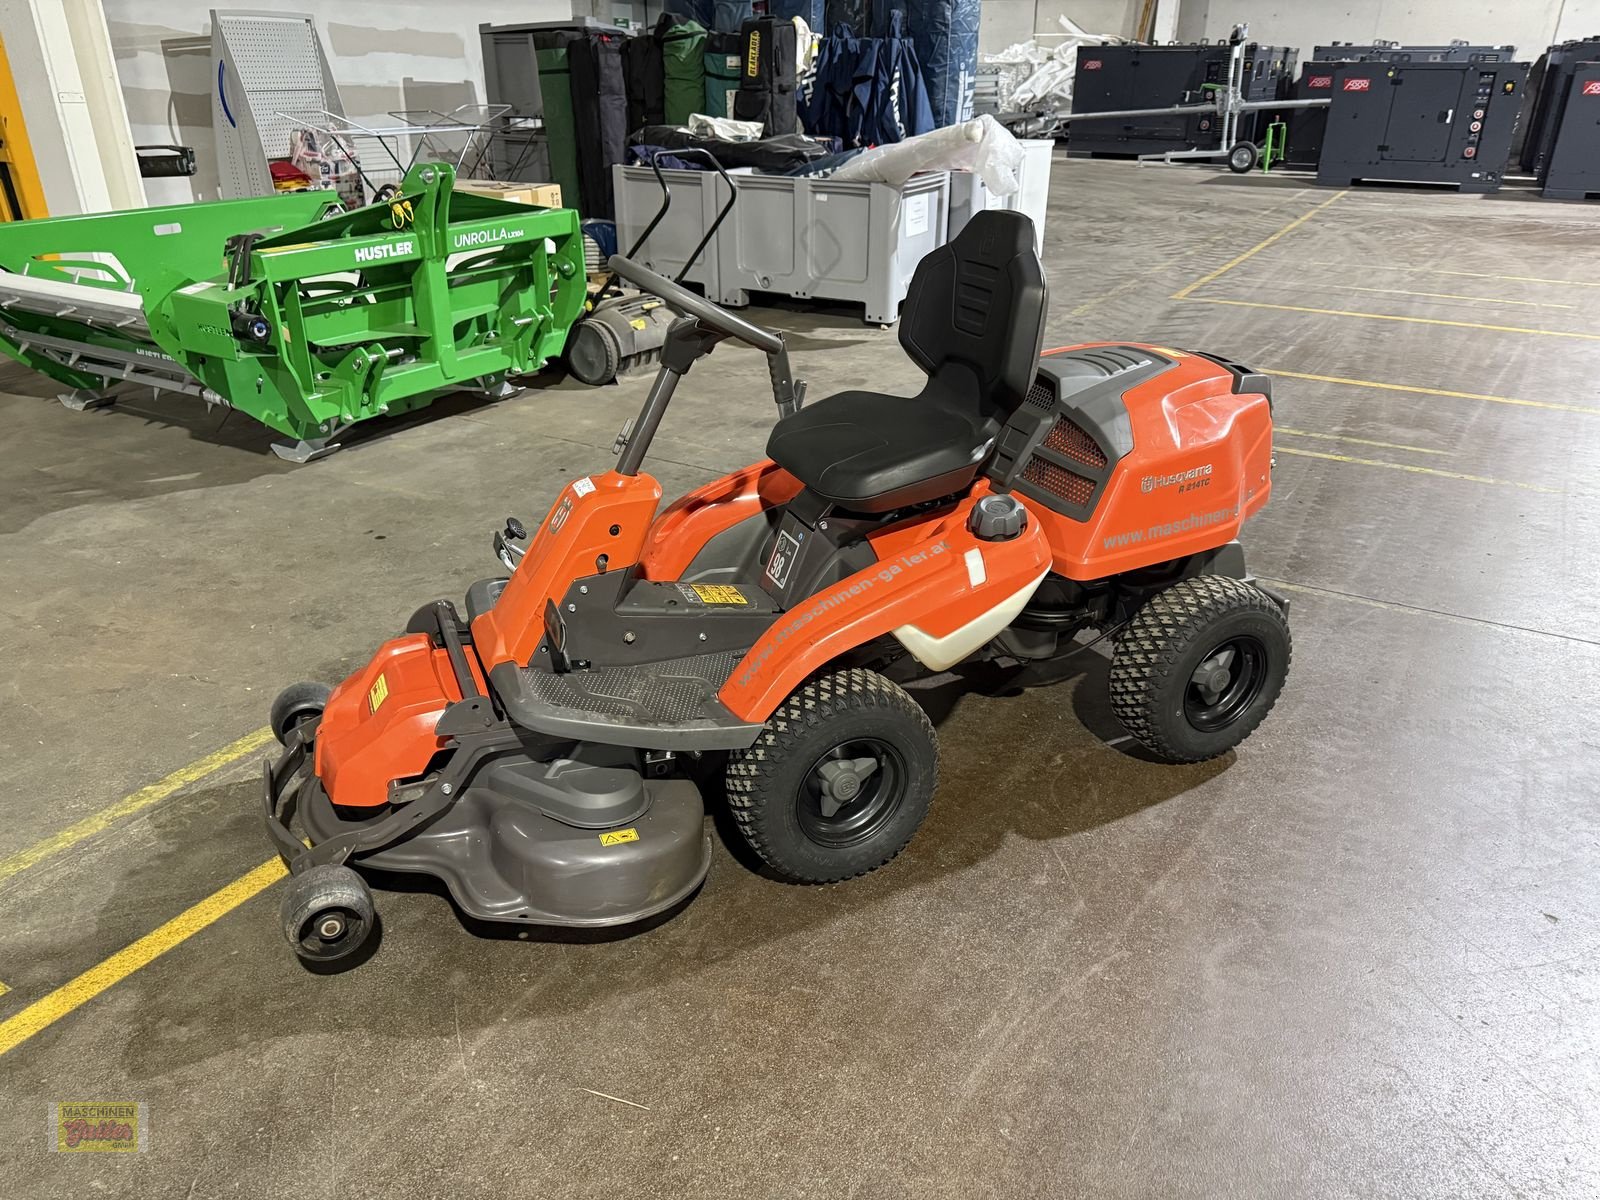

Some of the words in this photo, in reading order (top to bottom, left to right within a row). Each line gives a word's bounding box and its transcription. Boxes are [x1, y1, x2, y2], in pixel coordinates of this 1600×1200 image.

[454, 227, 507, 248] UNROLLA
[354, 241, 413, 262] HUSTLER
[1153, 463, 1213, 489] Husqvarna
[1178, 485, 1185, 494] R
[1186, 478, 1211, 492] 214TC
[770, 552, 785, 579] 98
